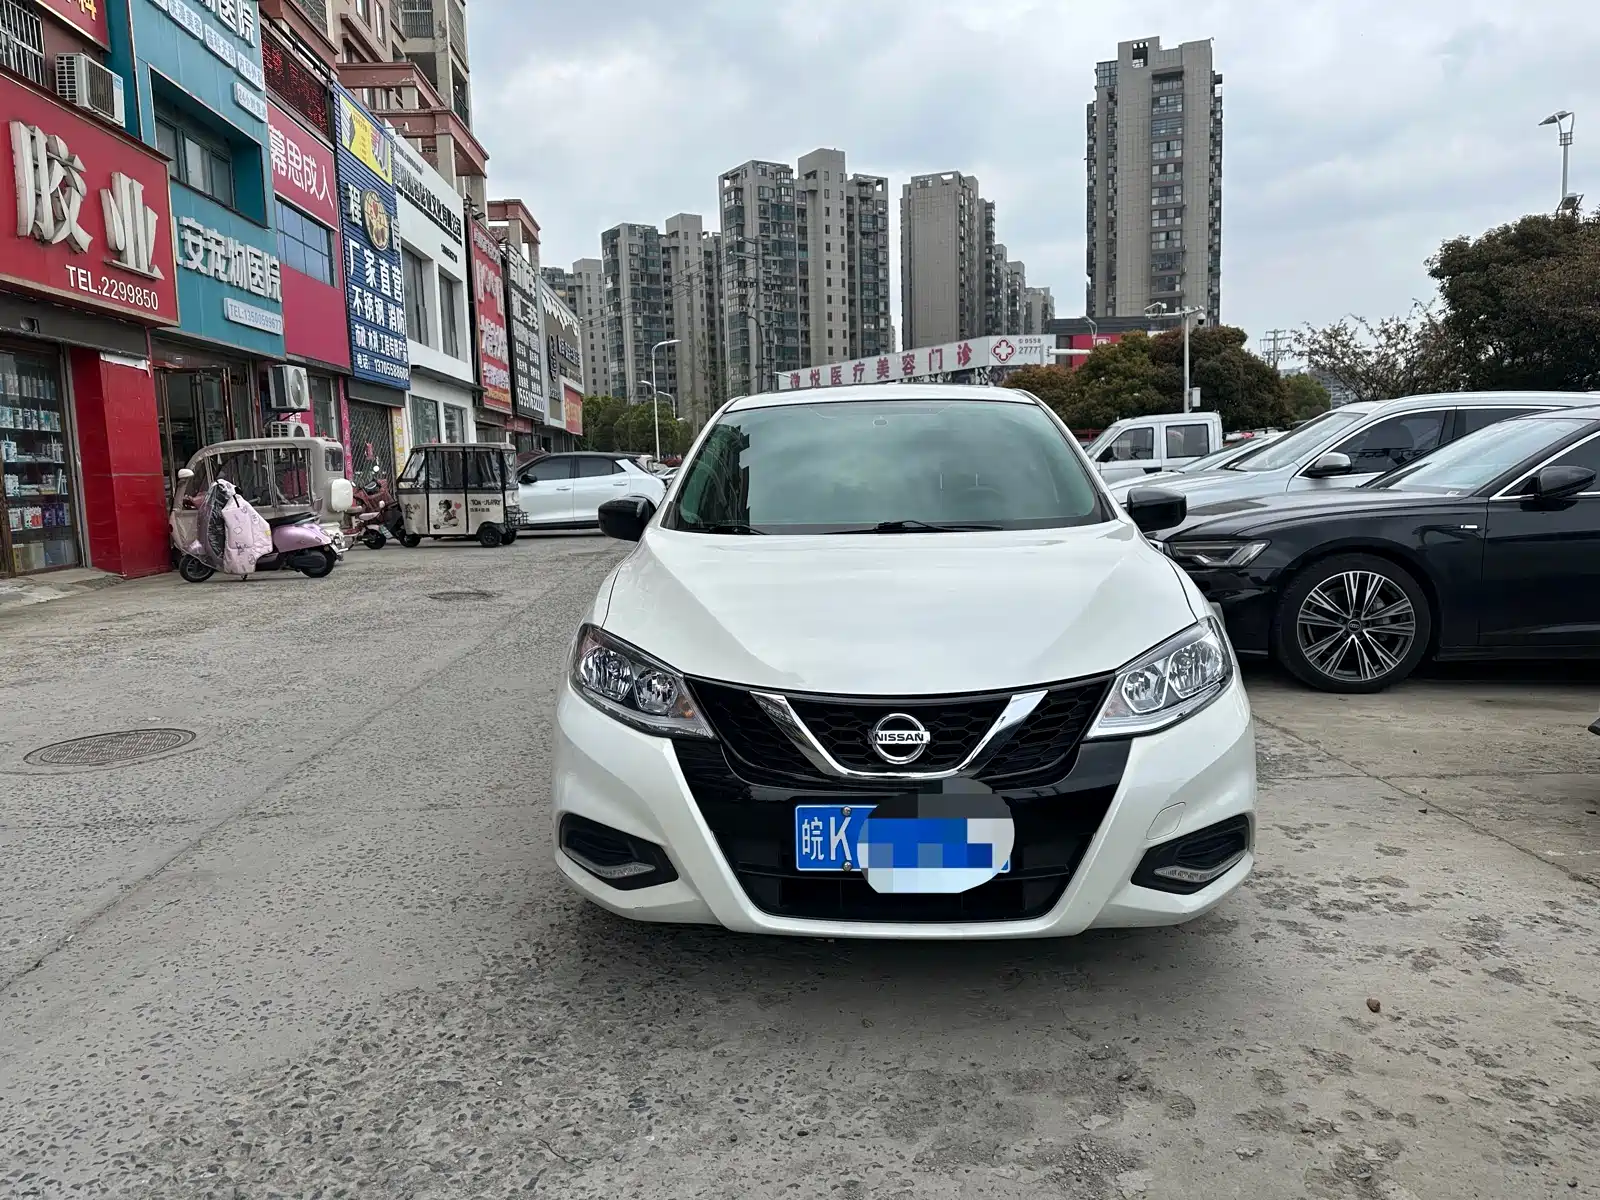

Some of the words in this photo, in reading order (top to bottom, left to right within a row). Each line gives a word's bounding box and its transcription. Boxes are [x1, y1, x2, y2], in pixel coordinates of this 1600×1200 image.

[66, 264, 158, 310] TEL:2299850
[349, 238, 402, 302] 厂家直营
[352, 285, 385, 327] 不锈钢
[388, 303, 405, 335] 消防
[875, 732, 924, 742] NISSAN
